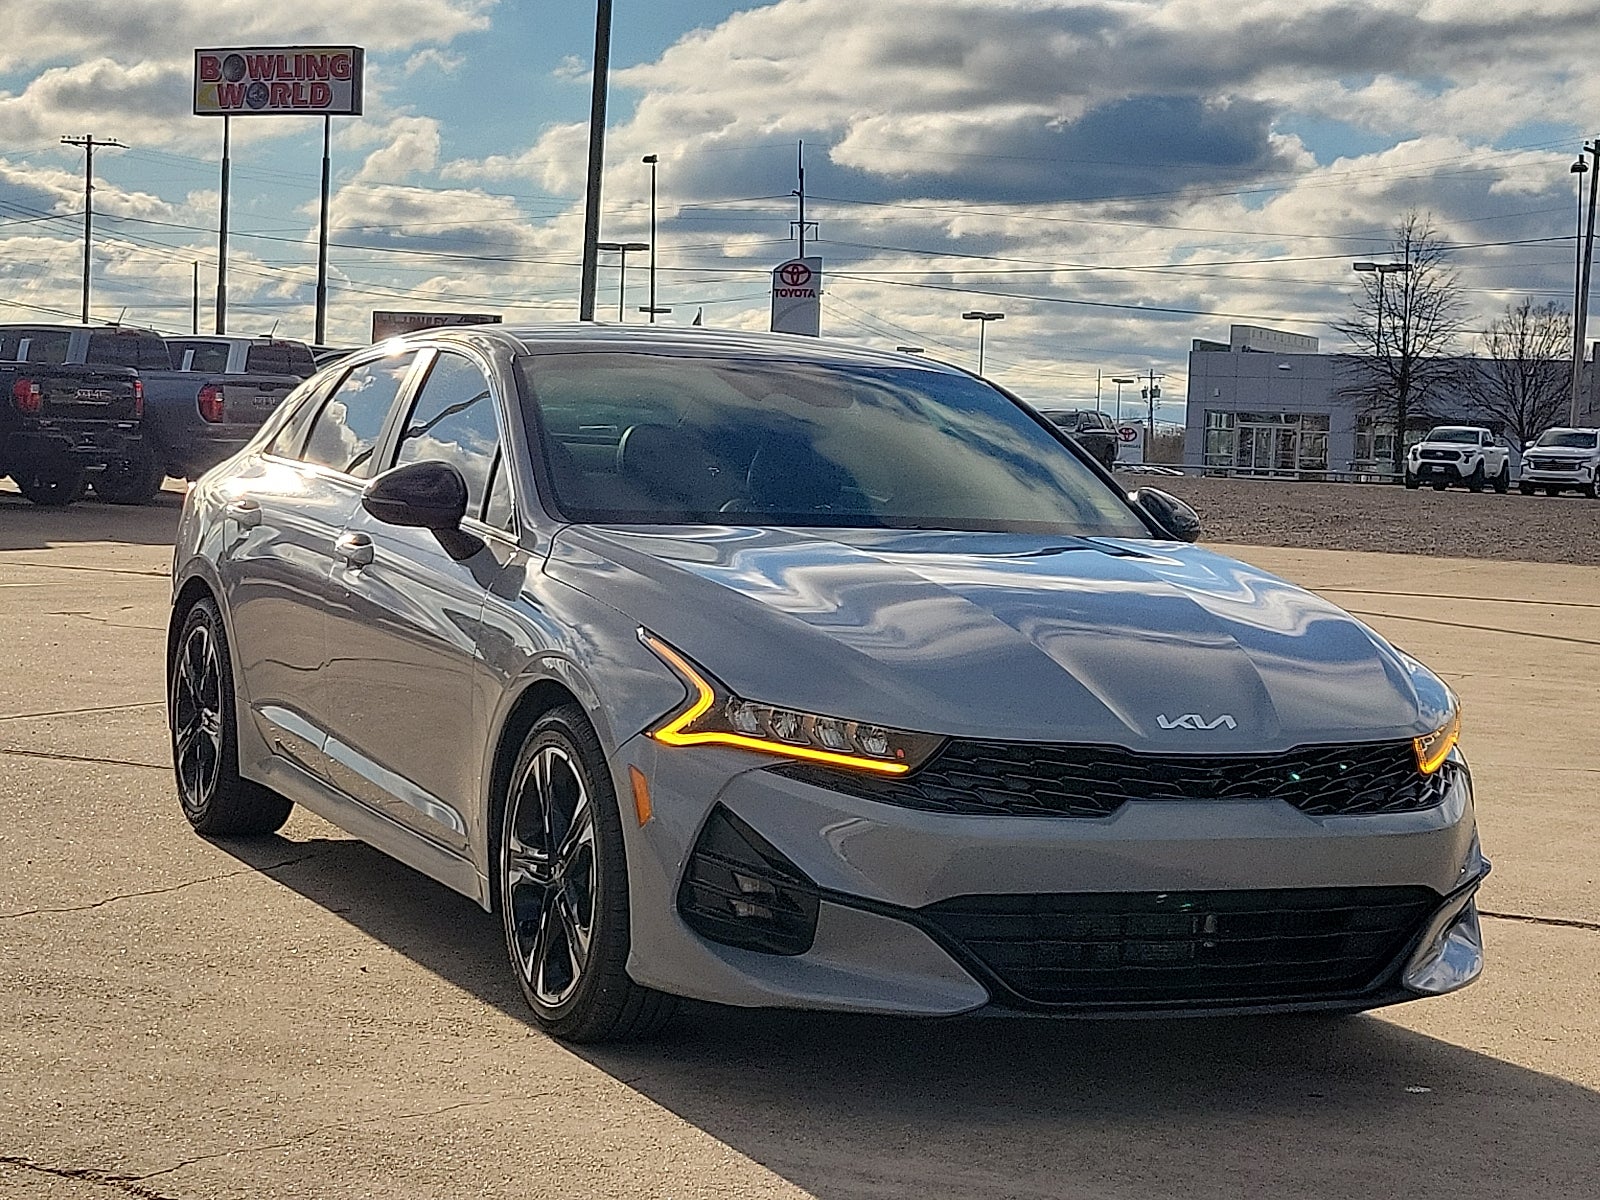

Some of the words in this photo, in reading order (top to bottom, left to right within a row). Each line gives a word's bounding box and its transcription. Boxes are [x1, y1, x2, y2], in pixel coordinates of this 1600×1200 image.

[200, 54, 351, 82] BOWLING
[216, 82, 333, 109] WORLD
[774, 288, 816, 298] TOYOTA
[1156, 713, 1238, 730] KIA
